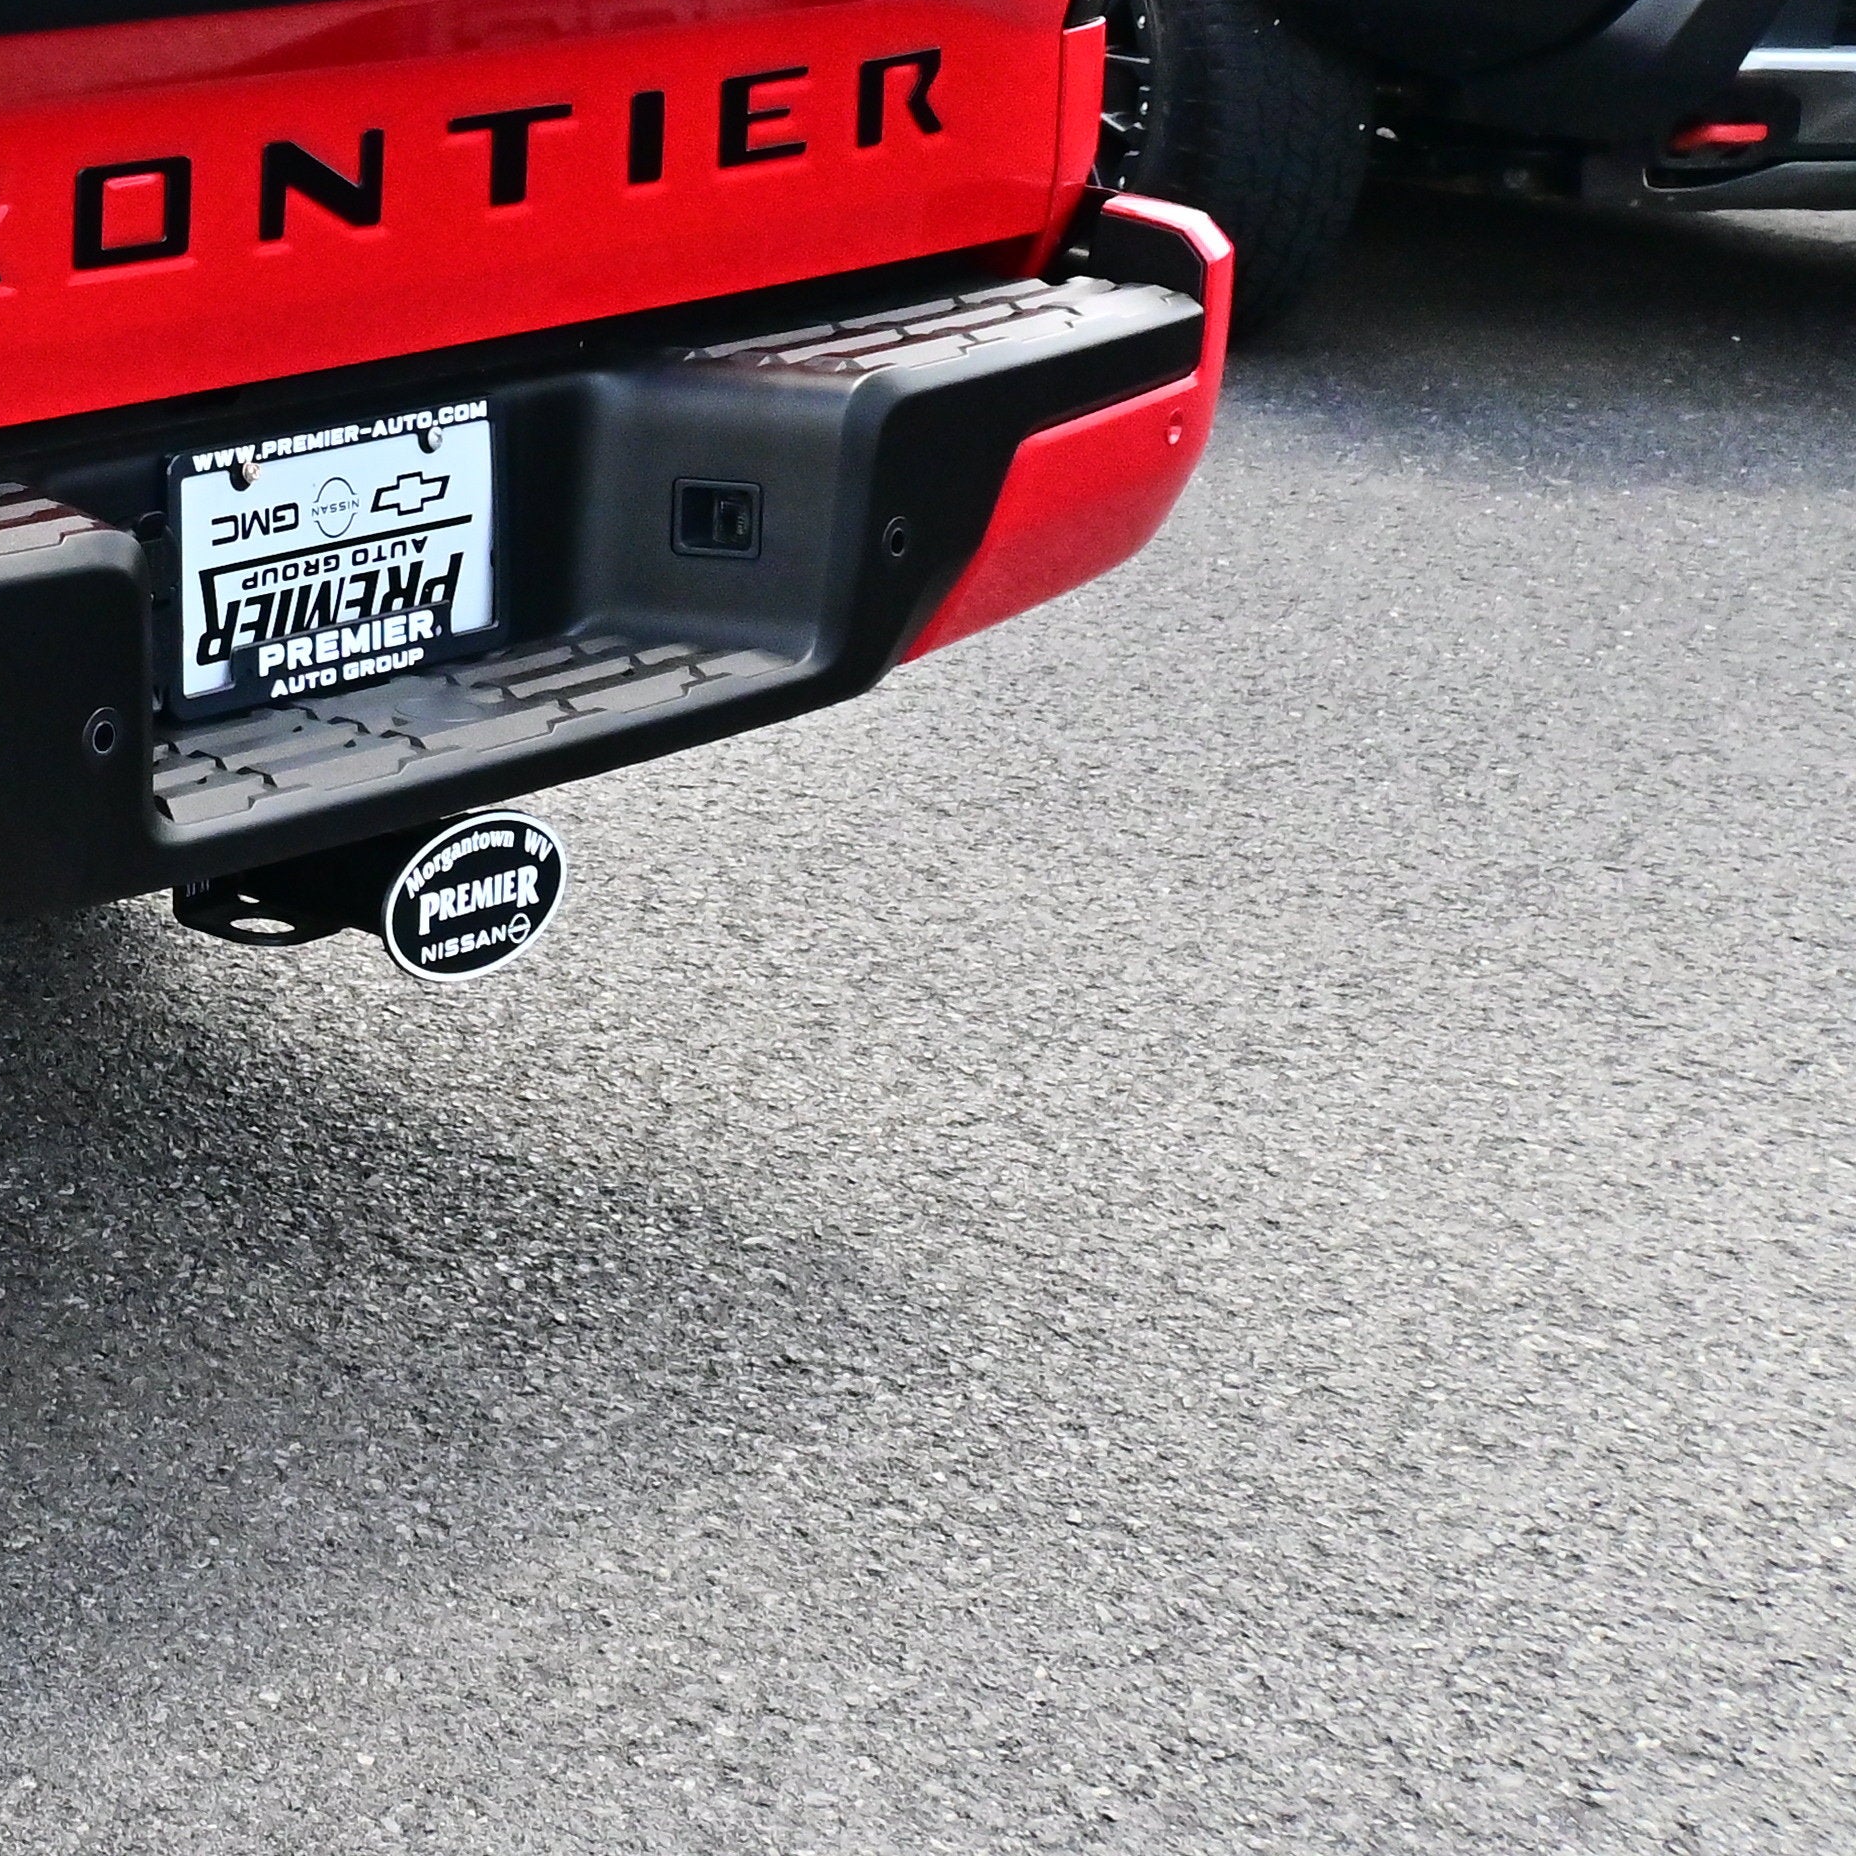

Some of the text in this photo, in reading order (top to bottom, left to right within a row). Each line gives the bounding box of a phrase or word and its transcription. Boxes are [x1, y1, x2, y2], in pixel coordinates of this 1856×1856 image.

[192, 399, 488, 473] WWW.PREMIER-AUTO.COM
[210, 497, 361, 547] GMC NISSAN
[241, 535, 429, 591] AUTO GROUP
[195, 551, 466, 667] PREMIER
[258, 608, 436, 678] PREMIER
[270, 647, 425, 699] AUTO GROUP
[404, 827, 554, 900] Morgantown WV
[418, 864, 540, 937] PREMIER
[421, 924, 508, 965] NISSAN
